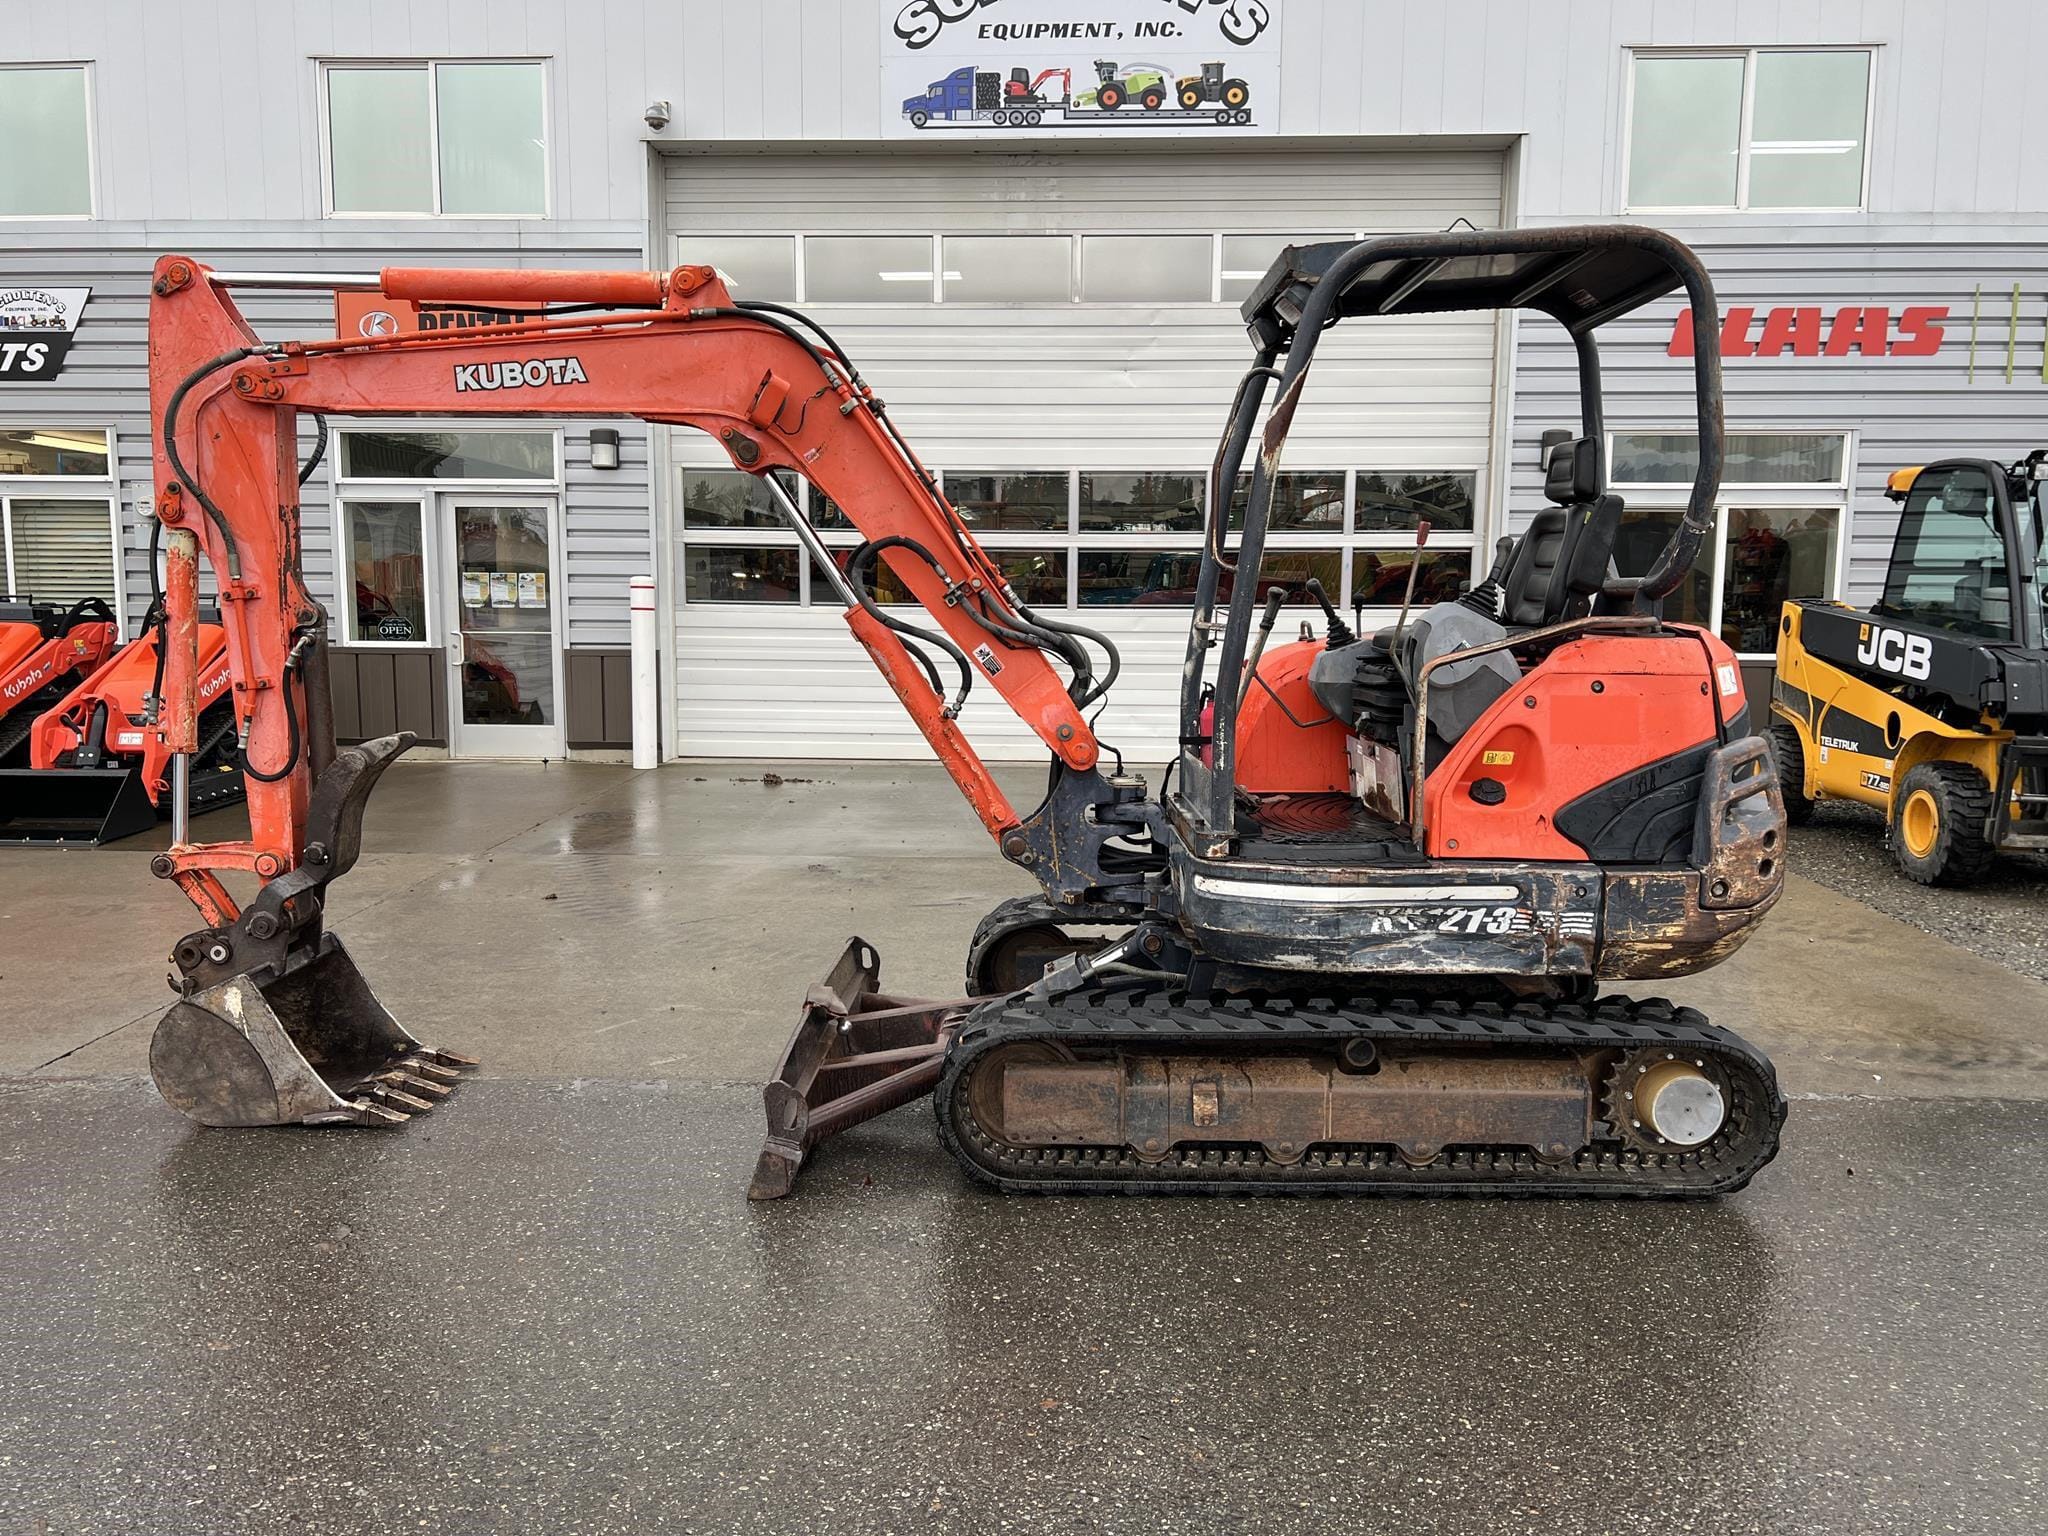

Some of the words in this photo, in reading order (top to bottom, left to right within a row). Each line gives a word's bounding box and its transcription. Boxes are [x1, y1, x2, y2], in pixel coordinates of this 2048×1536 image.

[977, 21, 1124, 41] EQUIPMENT,
[1133, 21, 1184, 38] INC.
[0, 343, 49, 372] TS
[454, 357, 589, 392] KUBOTA
[379, 626, 412, 635] OPEN
[1857, 625, 1933, 681] JCB
[4, 667, 43, 699] Kubota
[1821, 735, 1859, 752] TELETRUK
